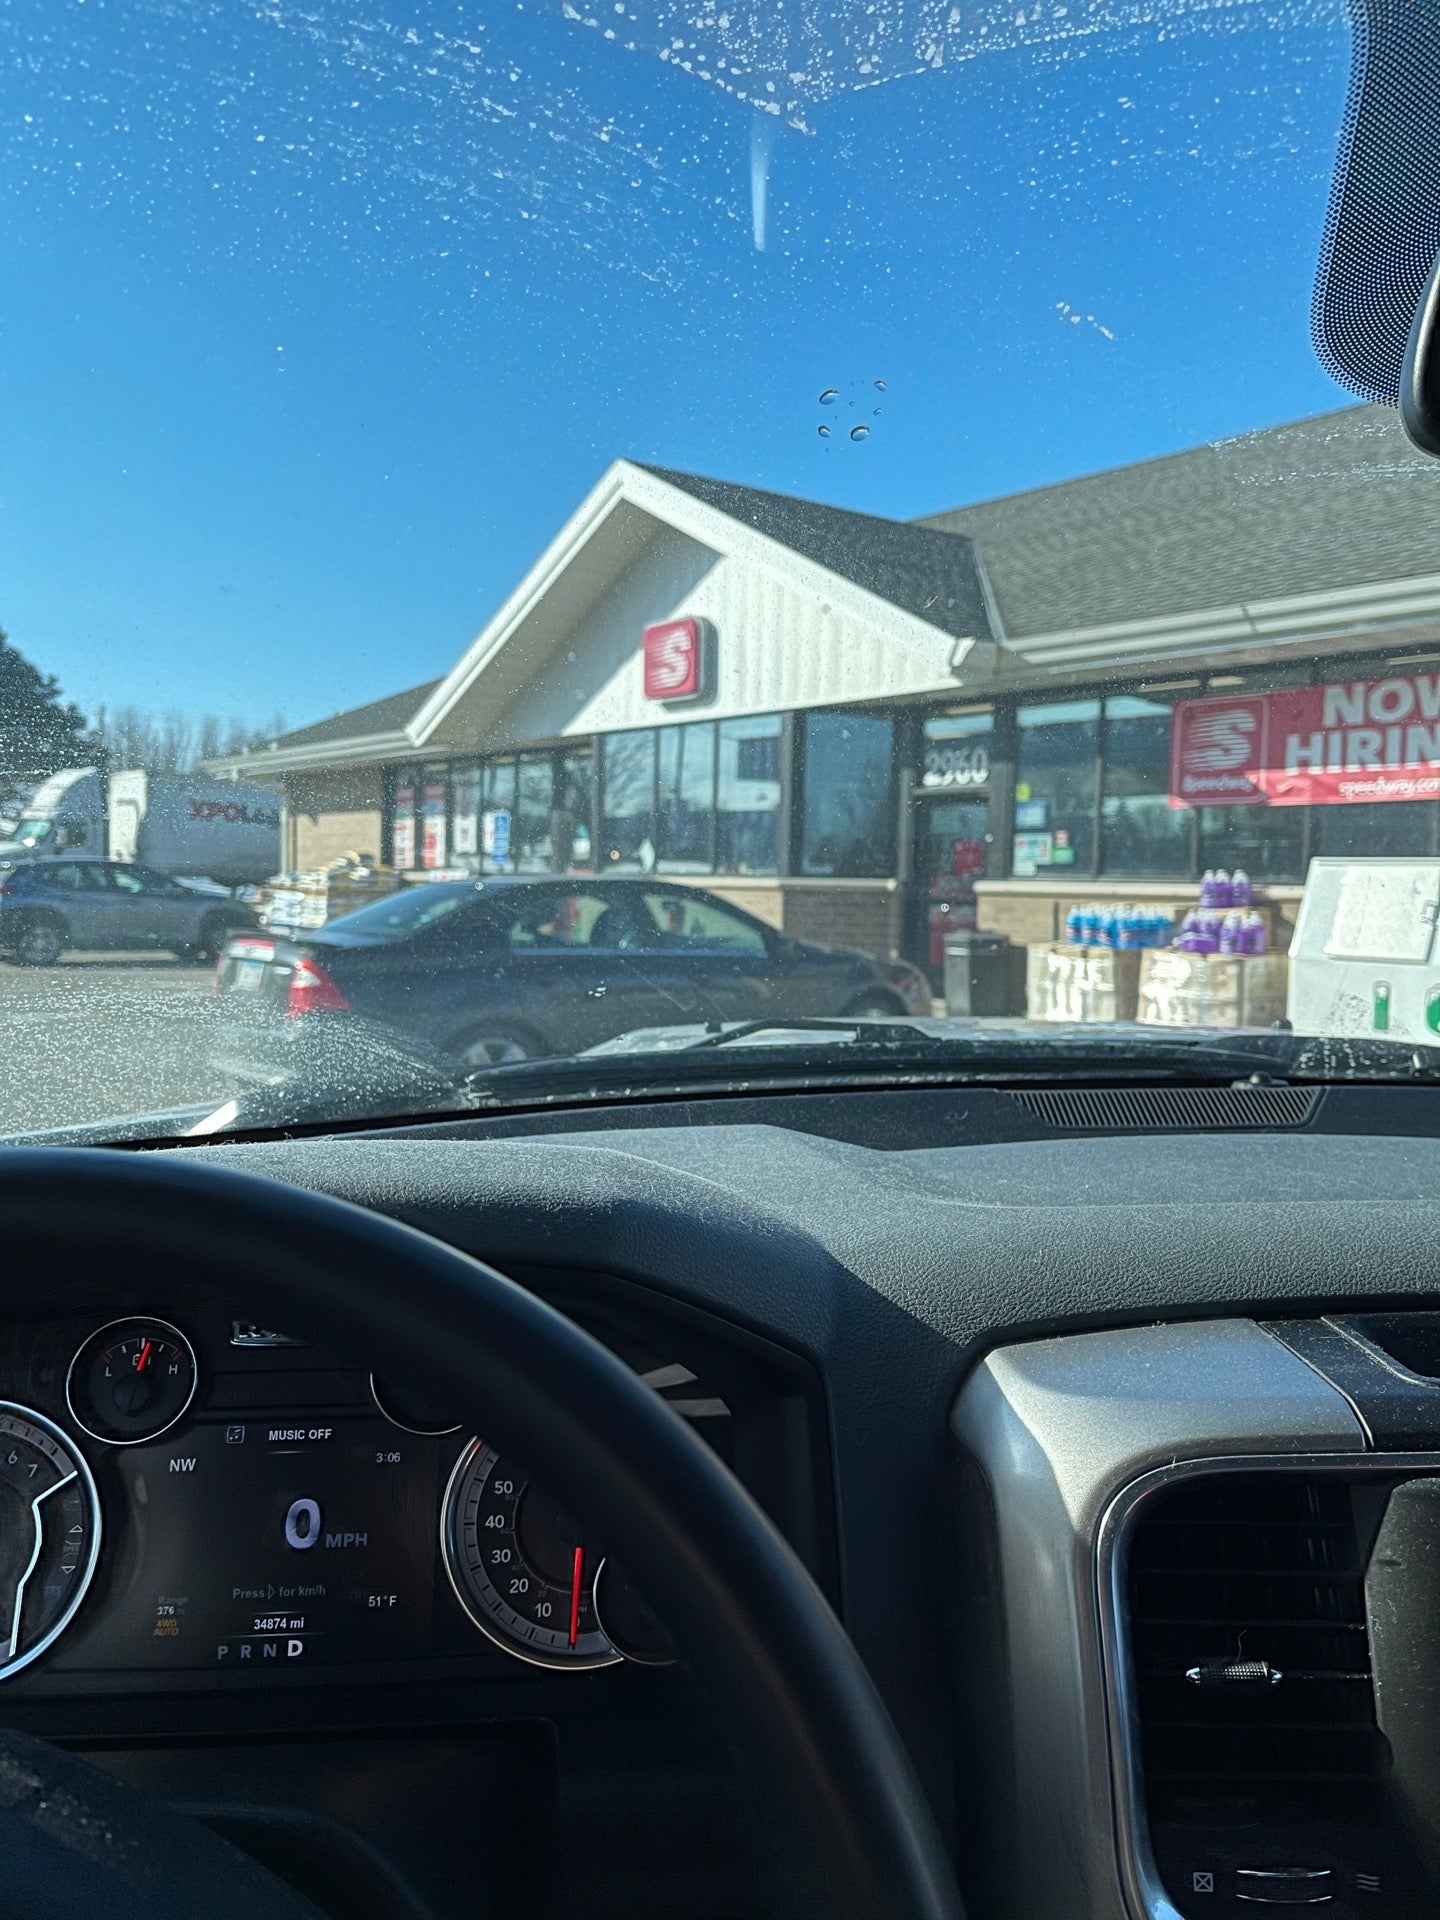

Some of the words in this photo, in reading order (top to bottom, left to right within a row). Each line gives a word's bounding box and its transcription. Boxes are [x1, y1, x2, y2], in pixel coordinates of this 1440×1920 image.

[649, 627, 692, 690] S
[268, 1429, 306, 1441] MUSIC
[308, 1428, 333, 1440] OFF
[8, 1450, 18, 1464] 6
[169, 1457, 197, 1472] NW
[375, 1452, 401, 1464] 3:06
[27, 1464, 38, 1478] 7
[494, 1480, 514, 1495] 50
[285, 1498, 321, 1549] 0
[325, 1532, 368, 1549] MPH
[485, 1514, 505, 1529] 40
[491, 1549, 511, 1564] 30
[232, 1588, 265, 1599] Press
[278, 1586, 296, 1598] for
[298, 1584, 326, 1597] km/h
[509, 1578, 529, 1594] 20
[157, 1606, 175, 1616] 376
[535, 1603, 551, 1618] 10
[253, 1617, 287, 1630] 34874
[289, 1616, 305, 1629] mi
[217, 1645, 229, 1660] P
[240, 1644, 251, 1659] R
[263, 1643, 277, 1658] N
[287, 1640, 303, 1657] D
